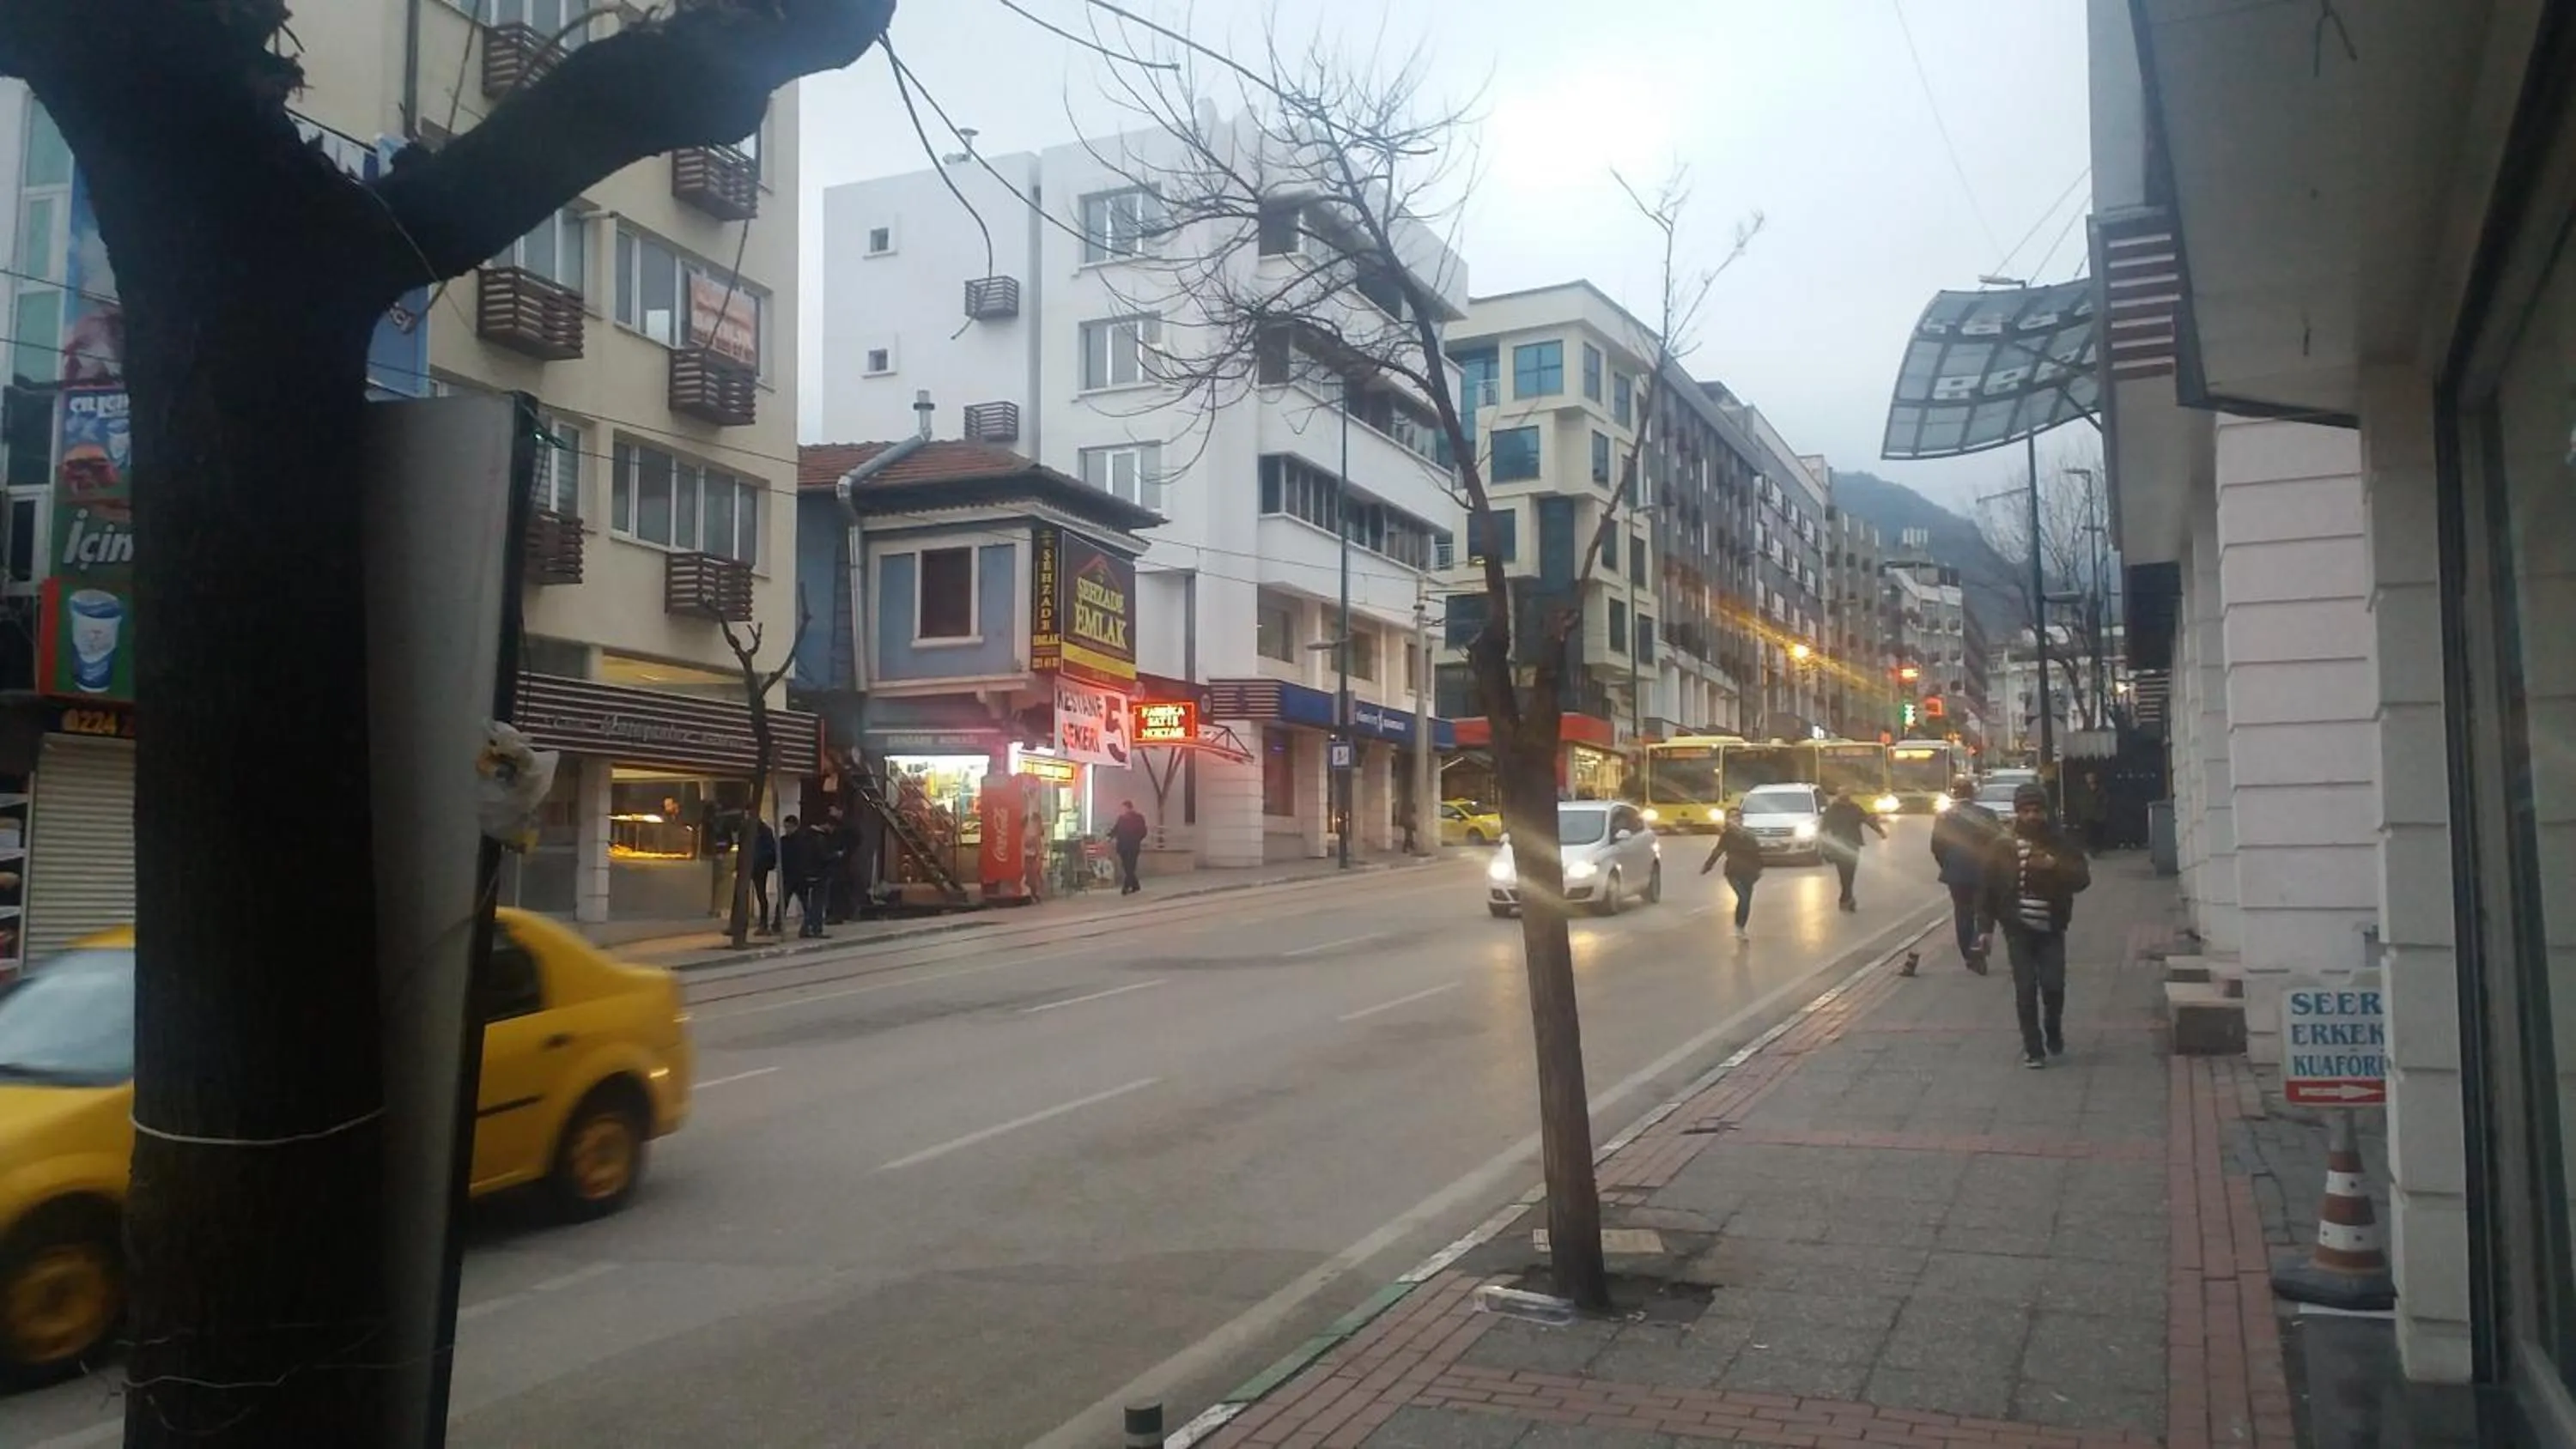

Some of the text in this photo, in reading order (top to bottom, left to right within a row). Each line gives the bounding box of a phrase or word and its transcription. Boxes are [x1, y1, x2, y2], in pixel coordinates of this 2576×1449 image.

[1074, 603, 1127, 650] EMLAK
[62, 709, 117, 734] 0224
[2291, 991, 2384, 1016] SEER
[2292, 1022, 2385, 1046] ERKEK
